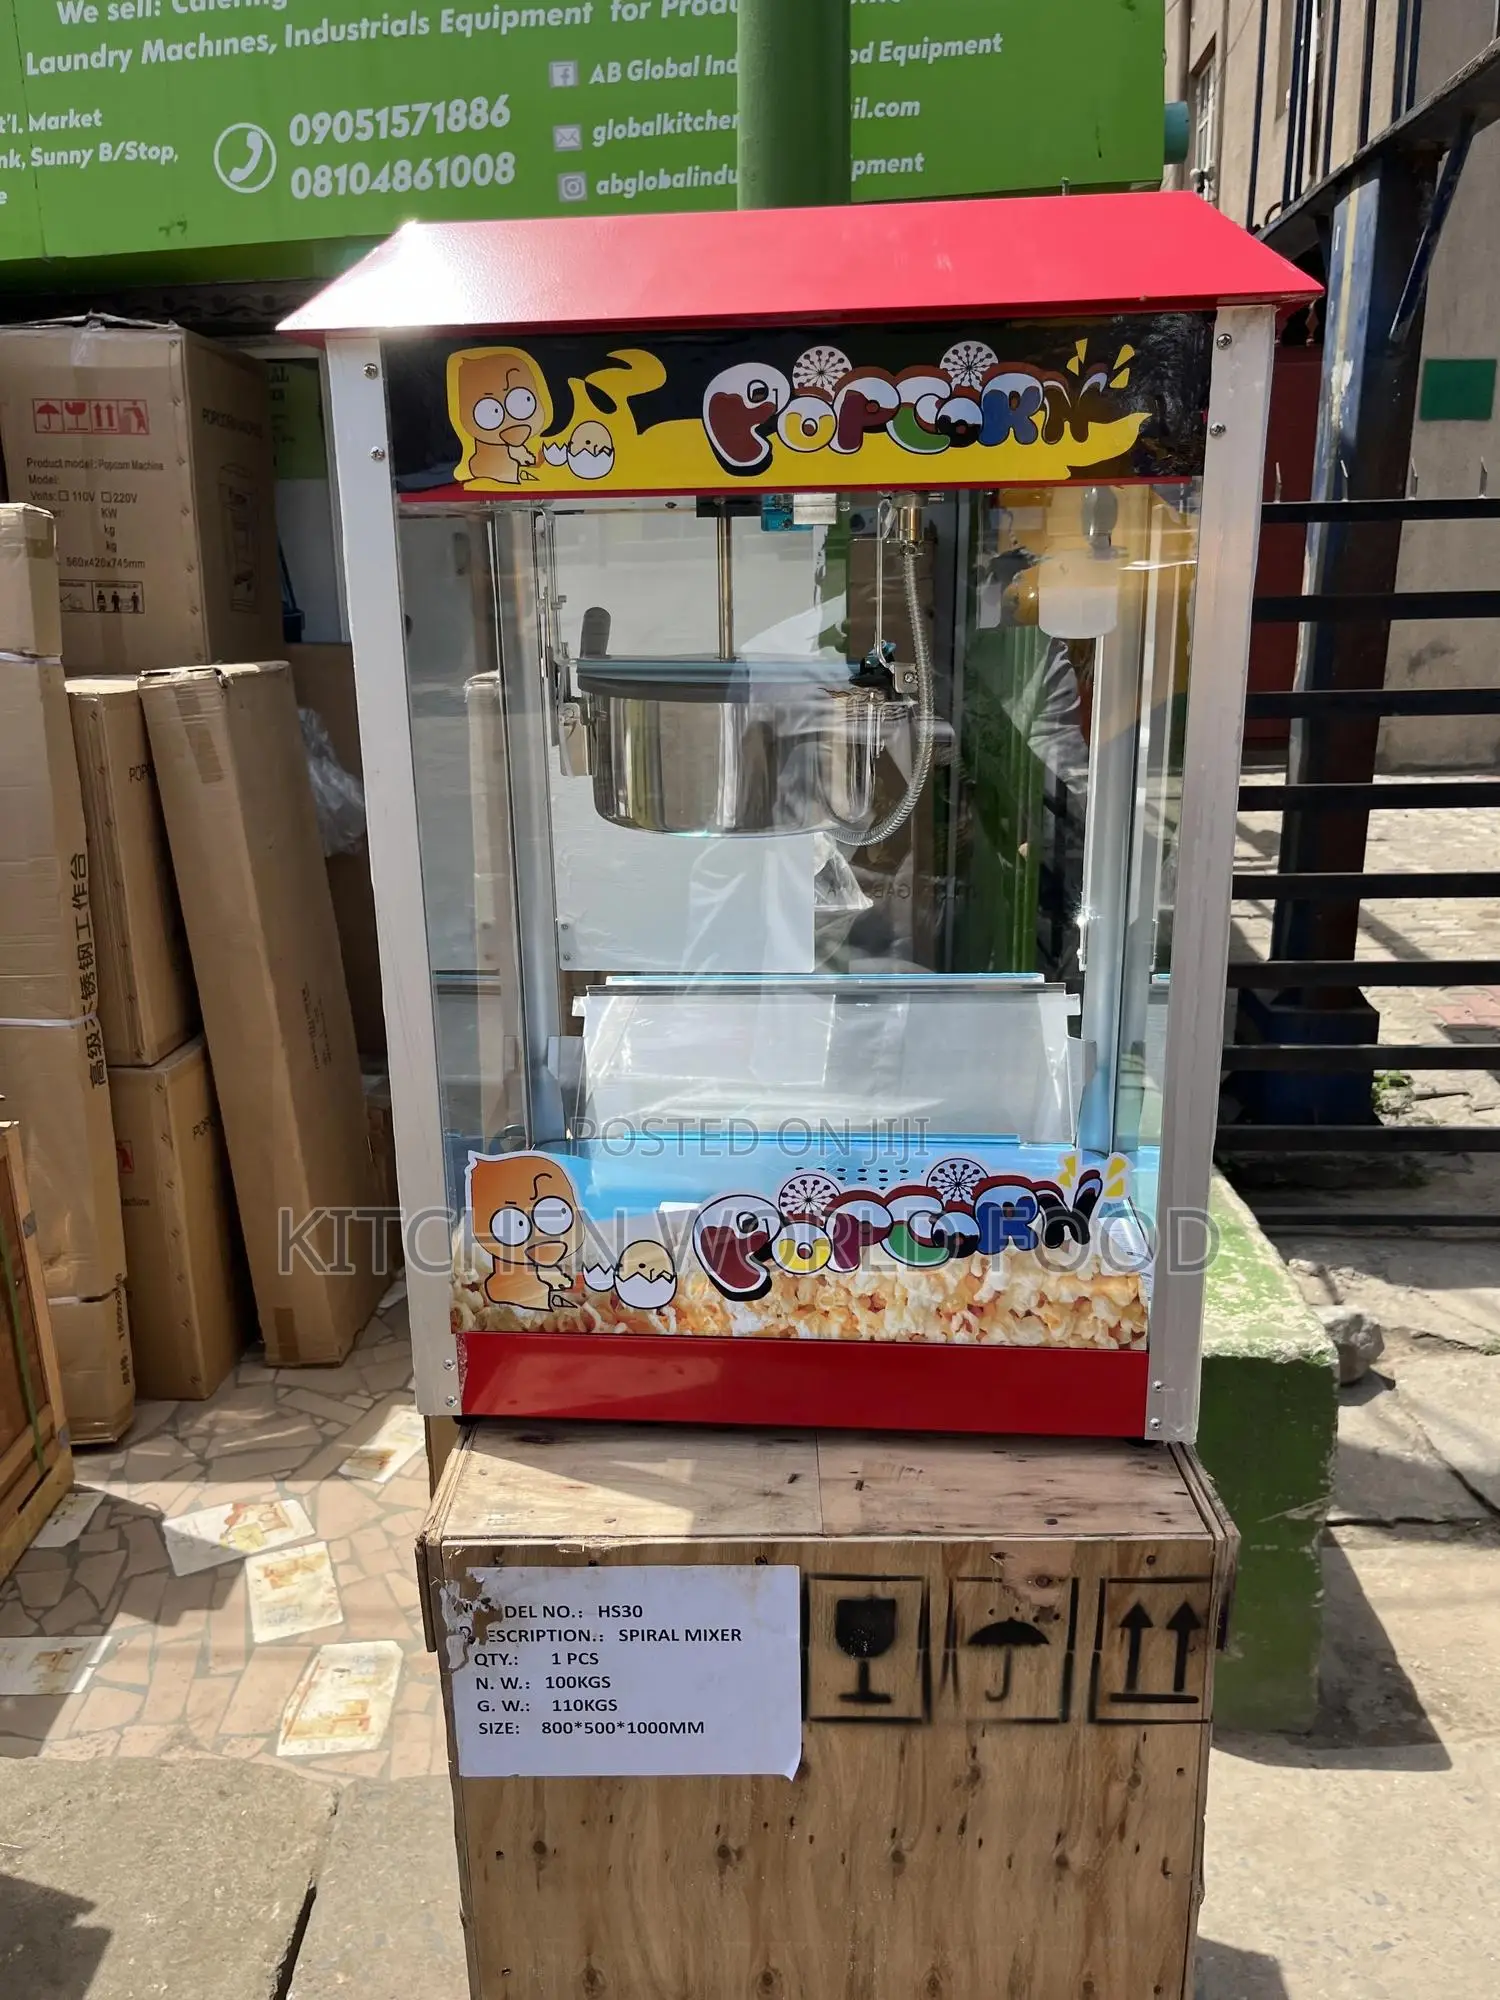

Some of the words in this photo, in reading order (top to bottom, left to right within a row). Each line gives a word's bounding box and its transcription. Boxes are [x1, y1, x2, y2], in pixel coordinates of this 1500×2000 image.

[58, 0, 99, 25] We
[108, 0, 161, 21] sell:
[26, 43, 132, 75] Laundry
[141, 32, 278, 65] Machines,
[285, 10, 430, 48] Industrials
[440, 2, 594, 38] Equipment
[610, 0, 651, 22] for
[588, 61, 622, 85] AB
[627, 55, 700, 82] Global
[878, 32, 1003, 67] Equipment
[28, 108, 103, 133] Market
[289, 93, 511, 147] 09051571886
[31, 147, 94, 169] Sunny
[99, 140, 179, 166] B/Stop,
[290, 151, 516, 200] 08104861008
[26, 457, 62, 469] Product
[72, 491, 96, 502] 110V
[113, 492, 138, 503] 220V
[504, 1605, 538, 1619] DEL
[598, 1605, 643, 1618] HS30
[618, 1628, 679, 1642] SPIRAL
[684, 1628, 742, 1642] MIXER
[551, 1652, 561, 1665] 1
[567, 1652, 599, 1665] PCS
[545, 1675, 611, 1689] 100KGS
[552, 1699, 618, 1712] 110KGS
[478, 1722, 520, 1735] SIZE:
